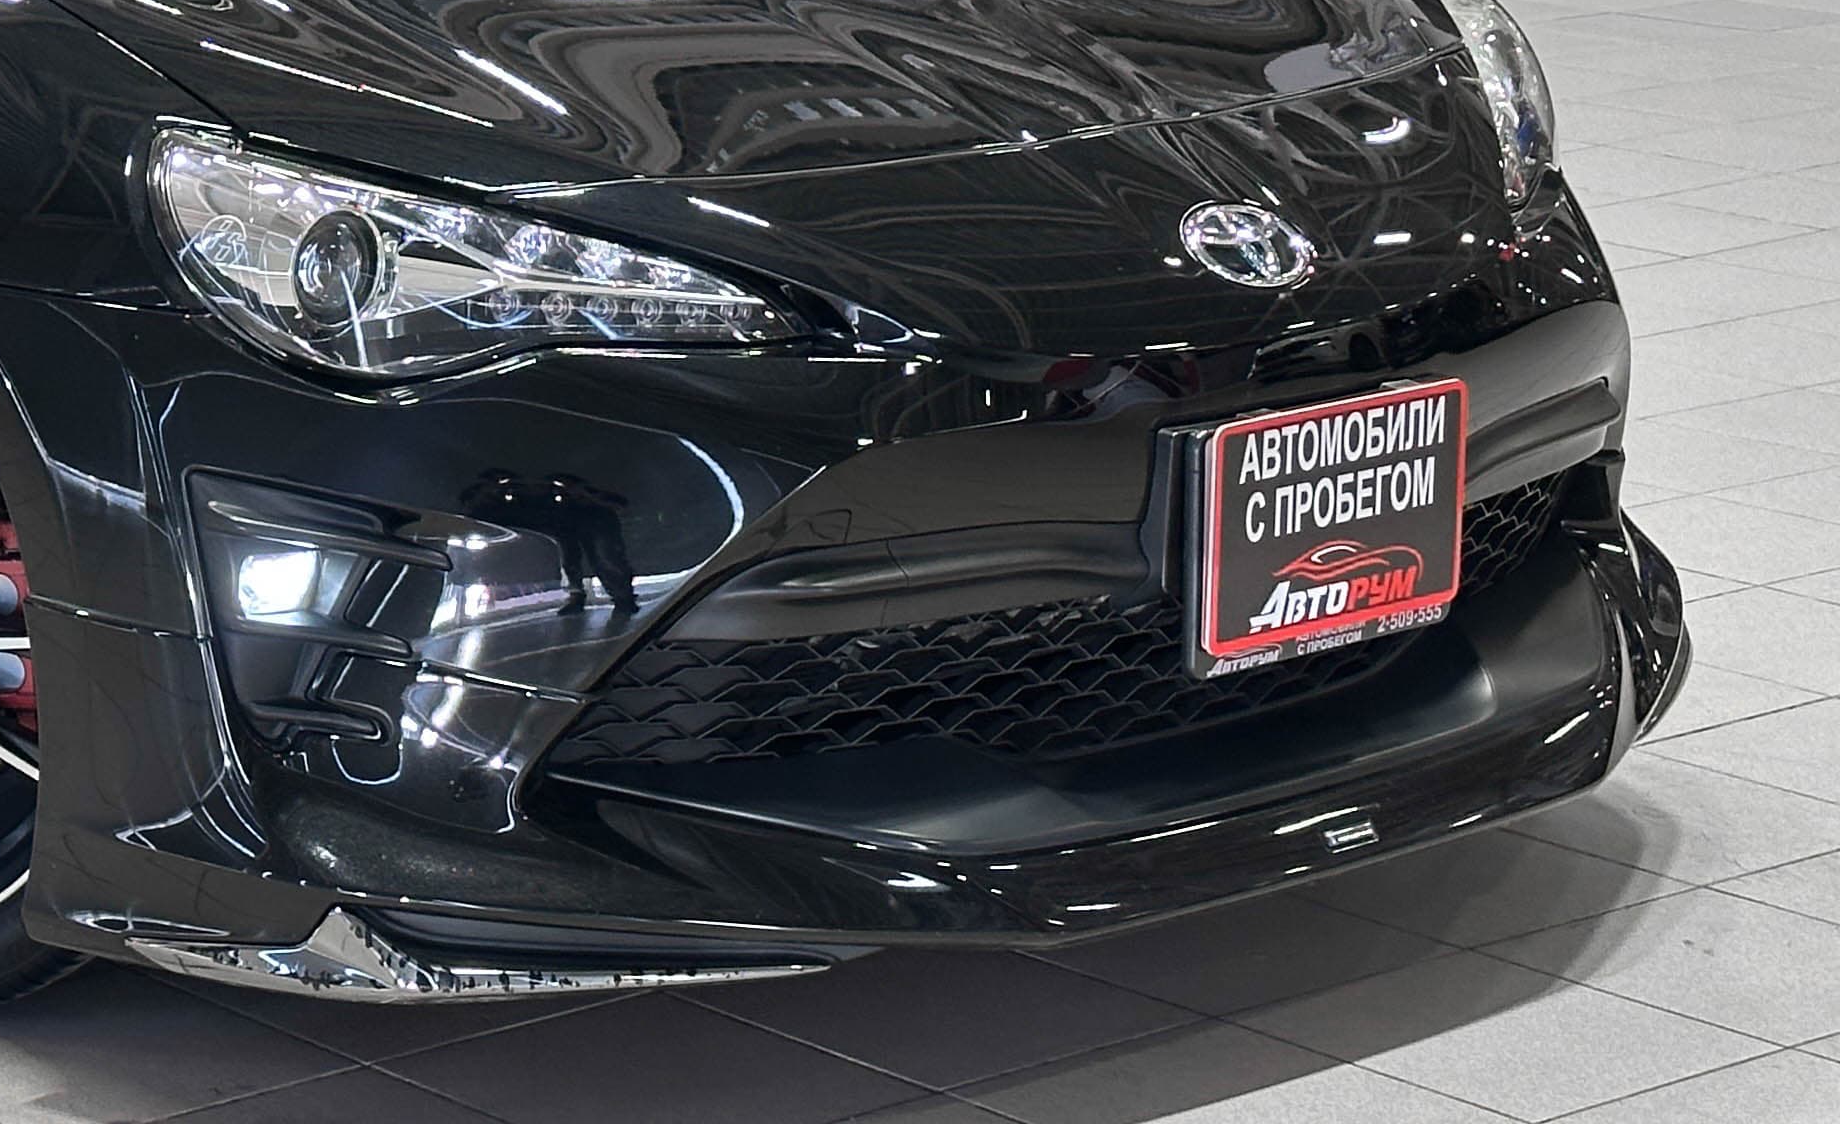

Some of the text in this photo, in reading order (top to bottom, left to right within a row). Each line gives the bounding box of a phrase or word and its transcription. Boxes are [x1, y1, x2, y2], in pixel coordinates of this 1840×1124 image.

[1238, 395, 1447, 484] АВТОМОБИЛИ
[1245, 456, 1436, 543] С ПРОБЕГОМ
[1306, 629, 1363, 654] ПРОБЕГОМ
